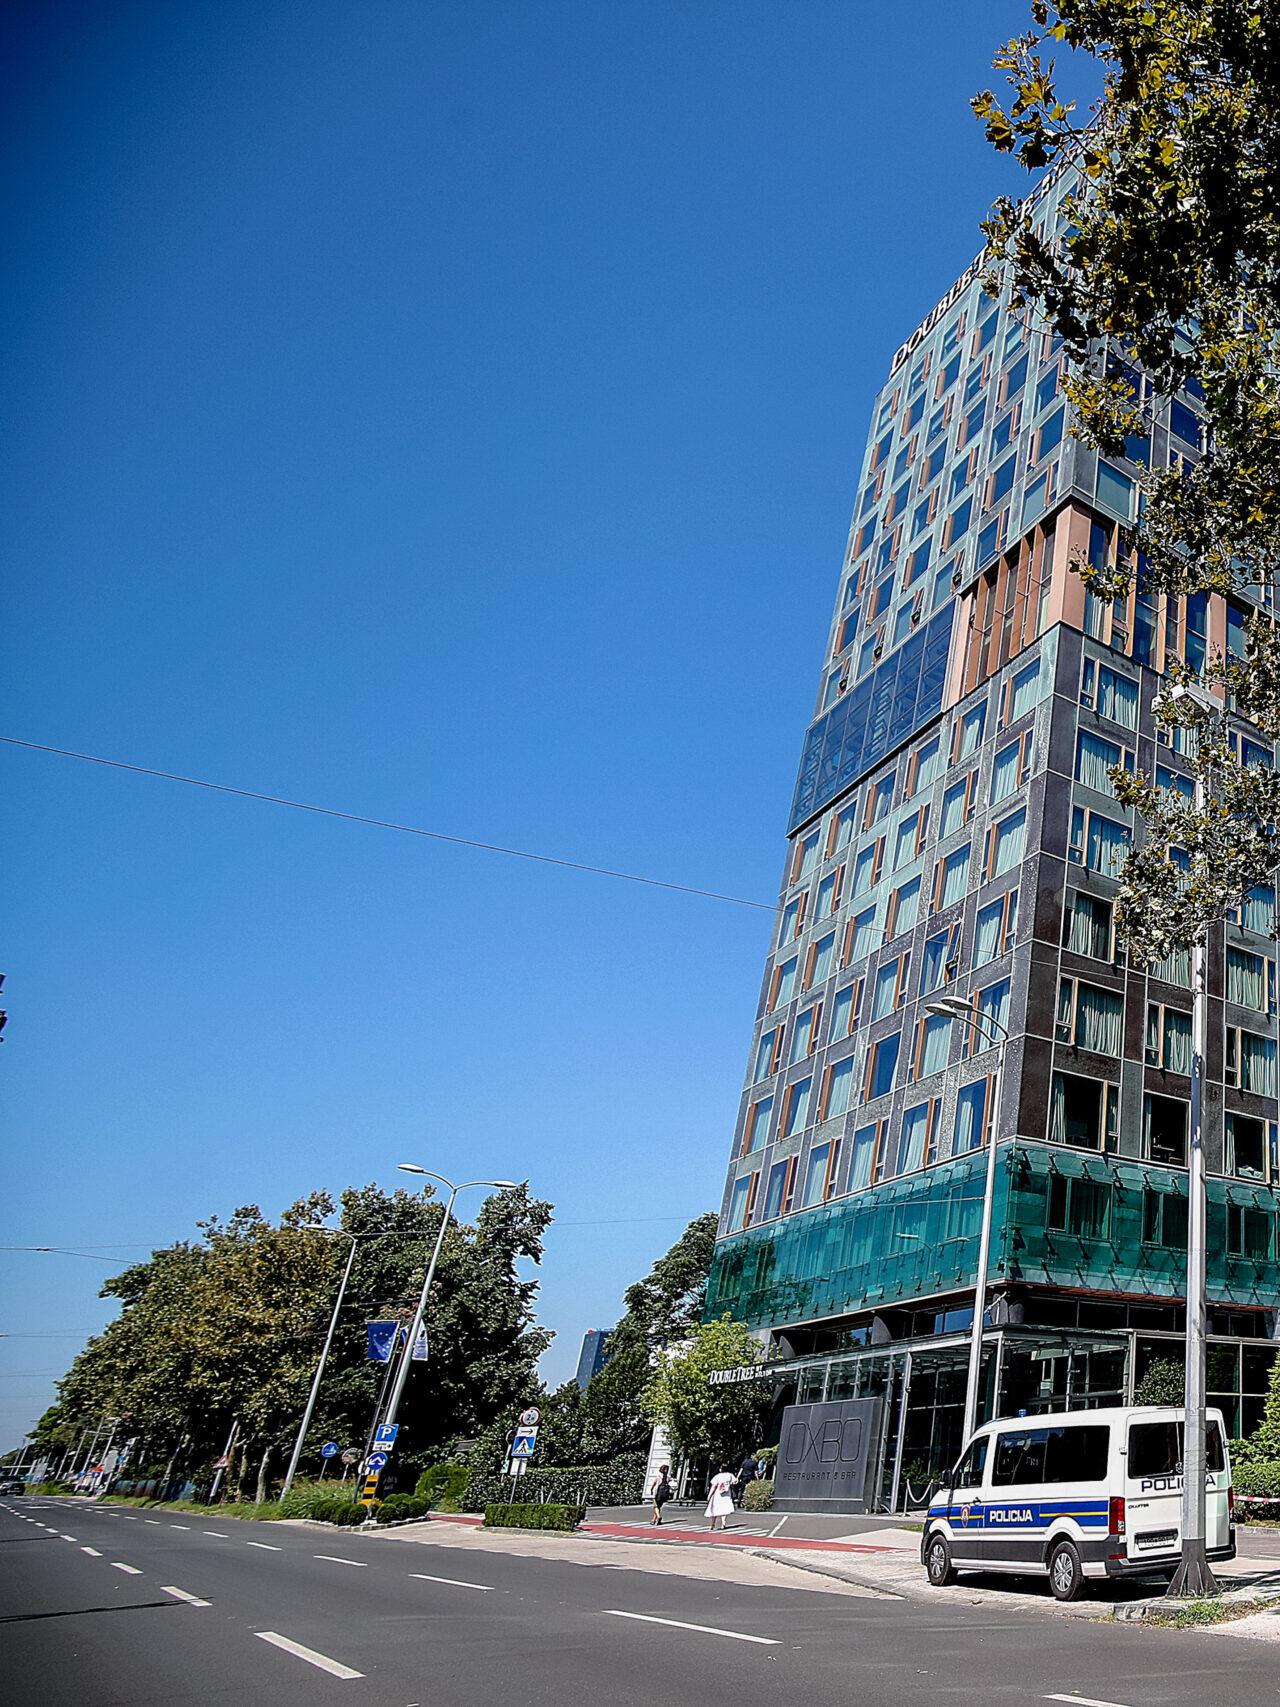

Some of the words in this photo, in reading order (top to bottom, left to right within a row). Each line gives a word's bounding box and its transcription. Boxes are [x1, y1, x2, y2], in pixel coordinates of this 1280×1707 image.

[381, 1427, 392, 1439] P
[785, 1417, 863, 1464] OXBO
[783, 1471, 831, 1481] RESTAURANT
[841, 1471, 856, 1480] BAR
[989, 1509, 1034, 1523] POLICIJA
